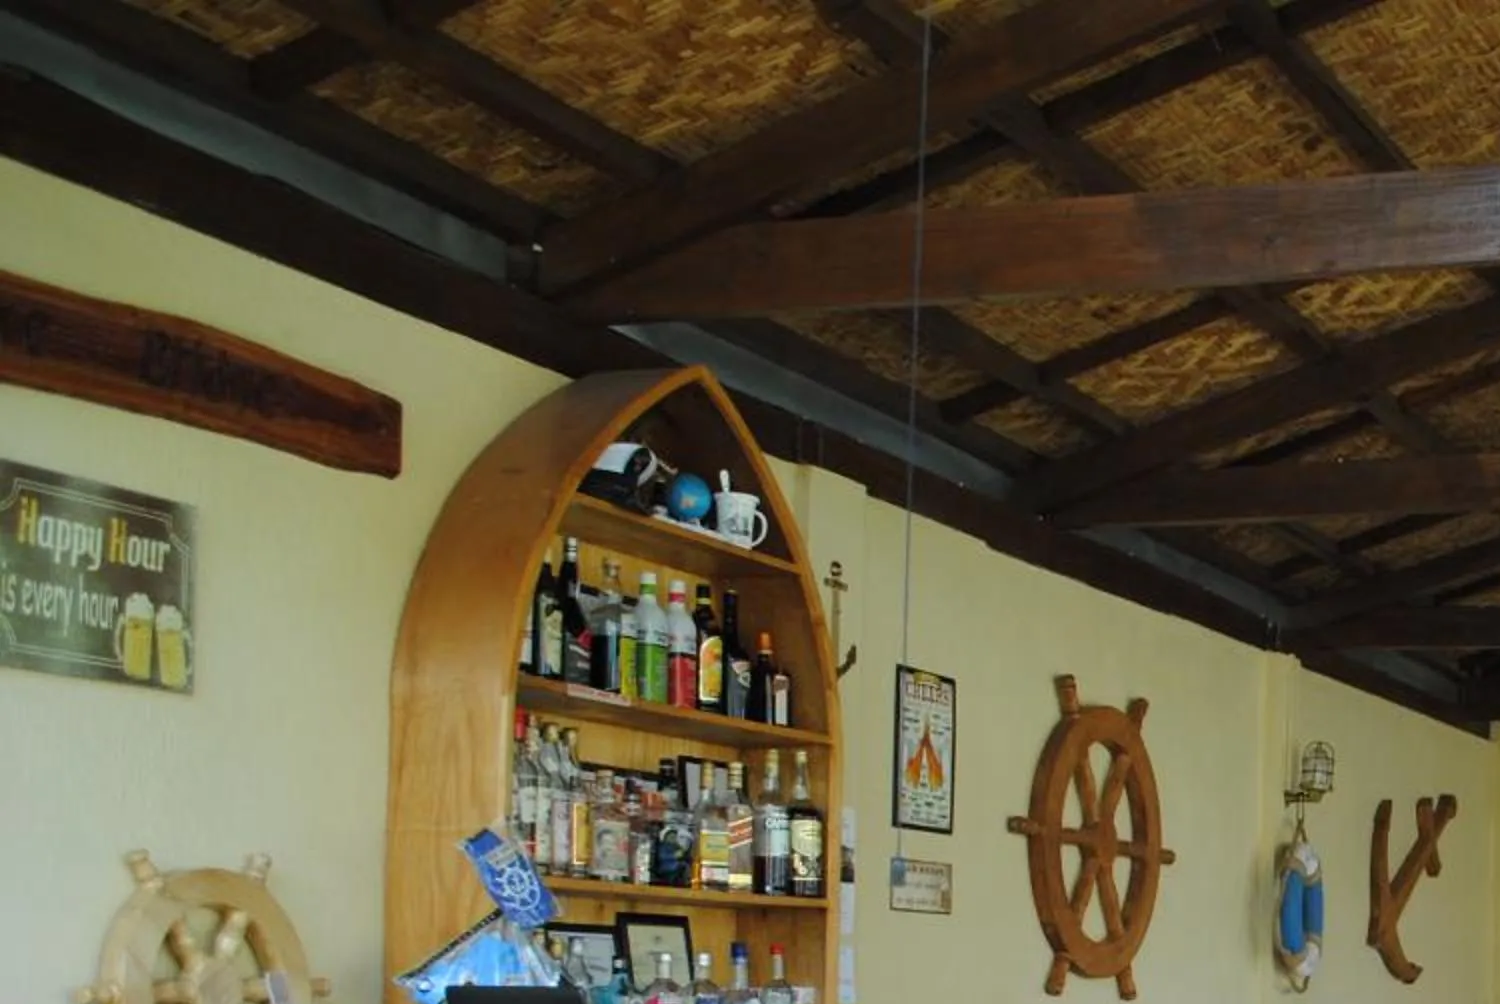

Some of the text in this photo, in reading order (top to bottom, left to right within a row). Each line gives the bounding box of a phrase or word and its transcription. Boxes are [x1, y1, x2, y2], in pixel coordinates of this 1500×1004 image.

[16, 496, 171, 573] Happy Hour
[21, 578, 74, 637] every
[79, 573, 119, 630] hour
